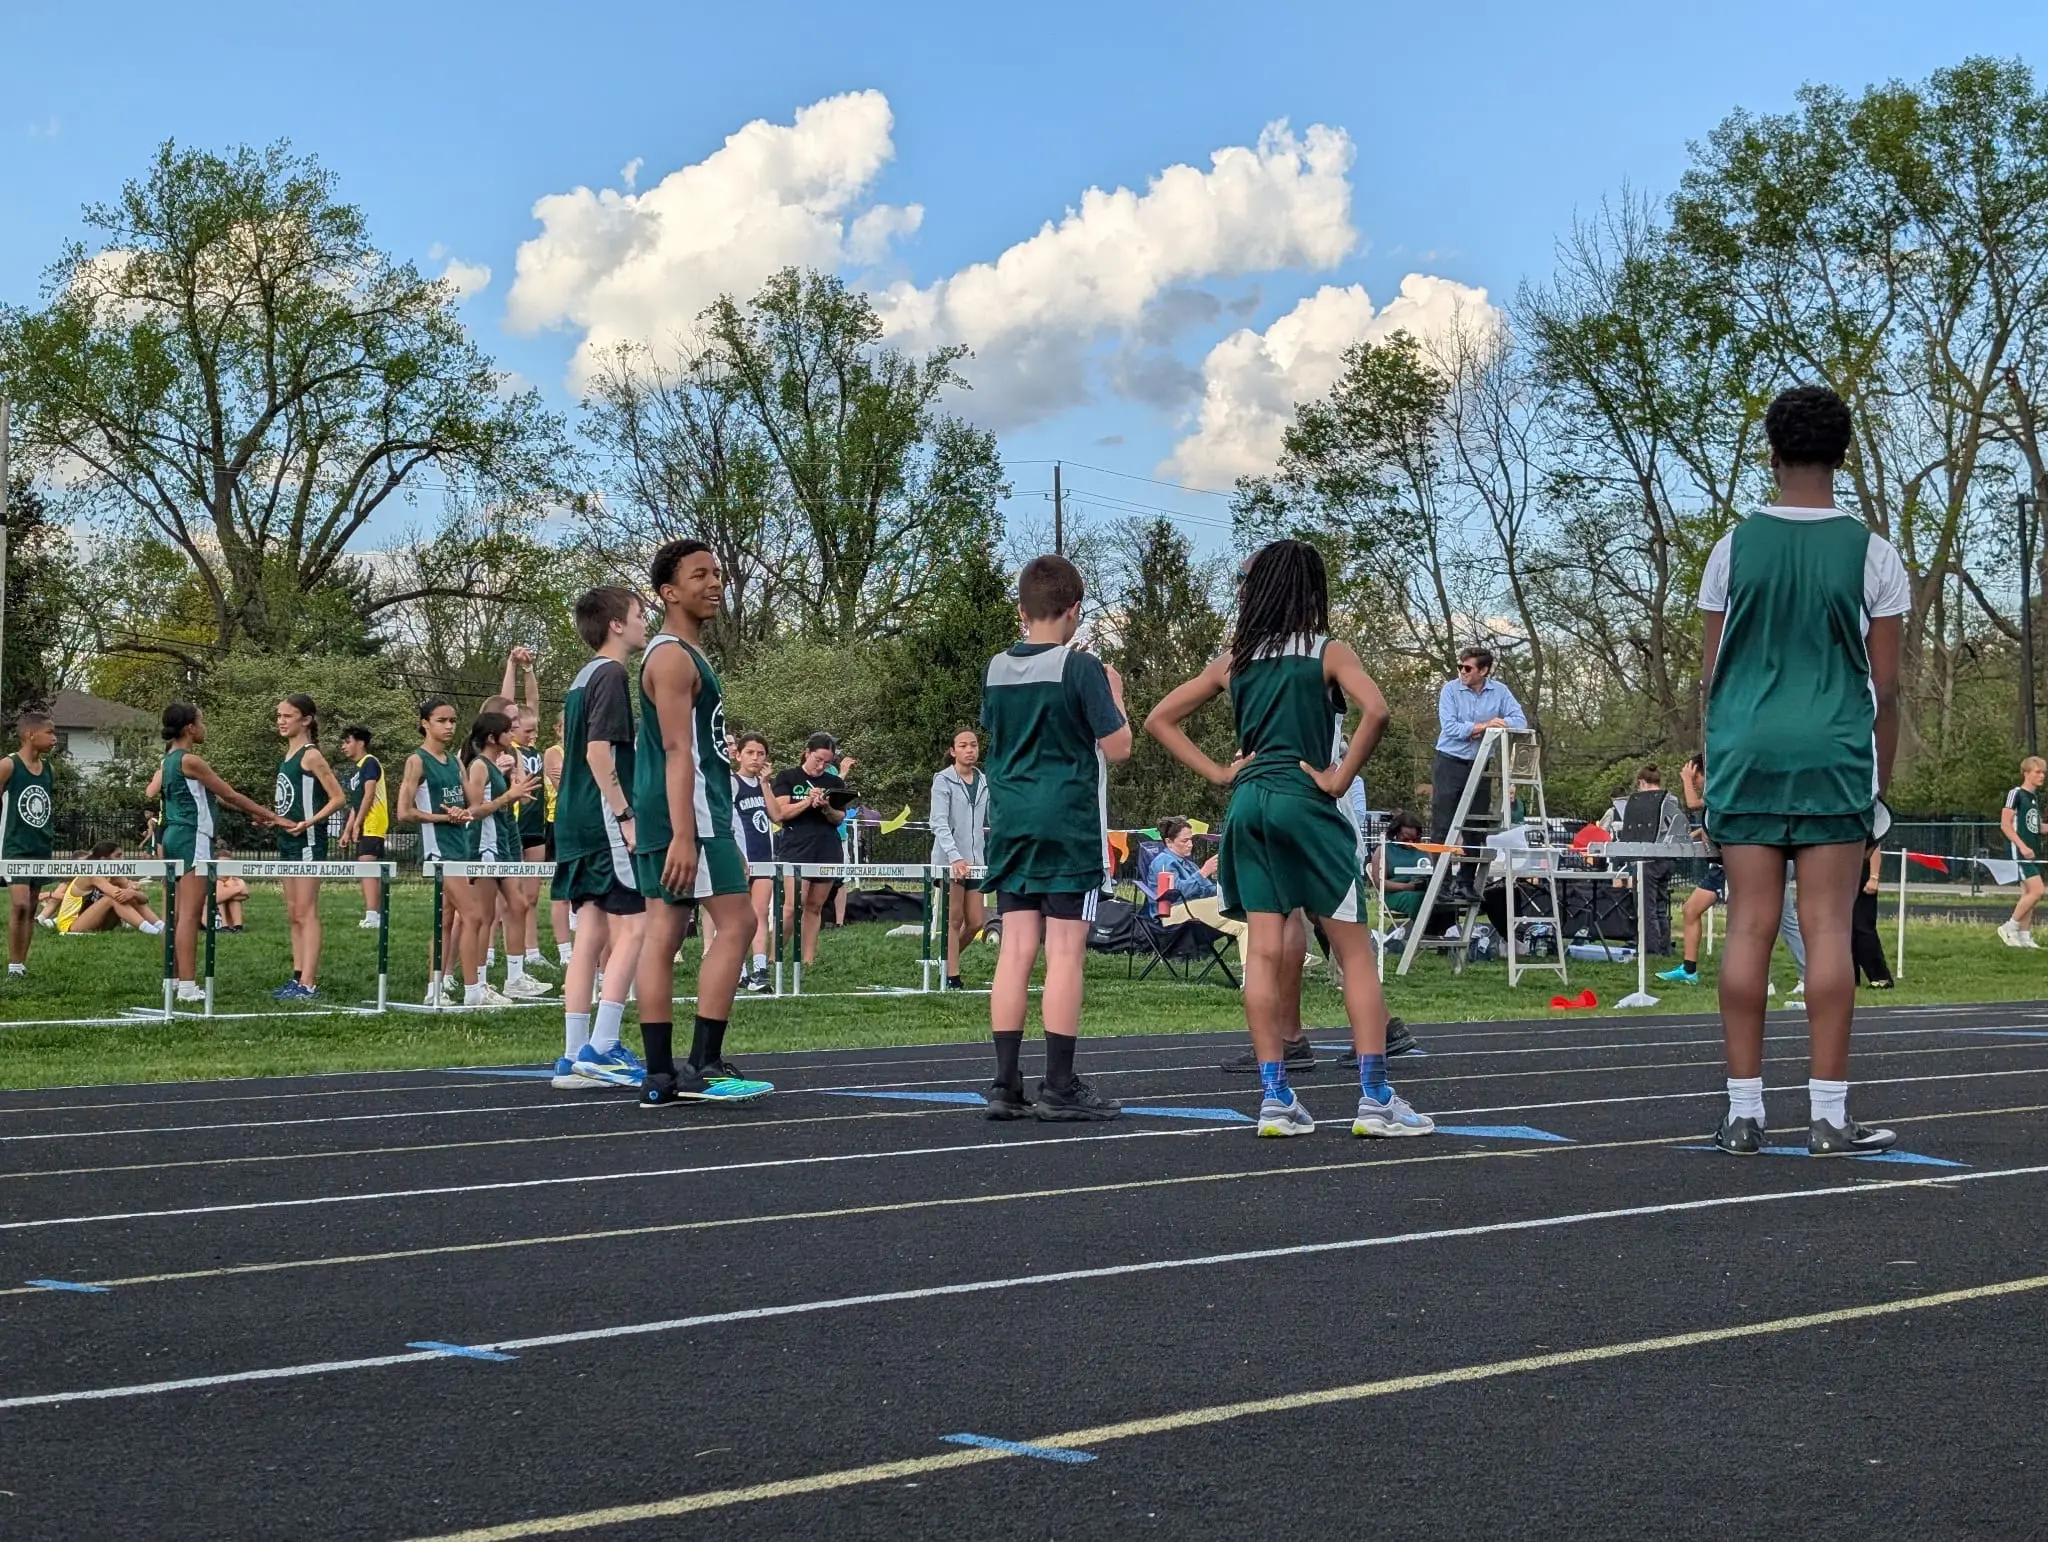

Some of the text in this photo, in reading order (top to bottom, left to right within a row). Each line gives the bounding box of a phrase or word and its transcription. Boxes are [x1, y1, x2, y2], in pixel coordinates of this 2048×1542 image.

[7, 863, 136, 875] GIFT OF ORCHARD ALUMNI
[242, 864, 355, 876] GIFT OF ORCHARD ALUMNI
[466, 865, 555, 875] GIFT OF ORCHARD ALU
[819, 866, 905, 876] GIFT OF ORCHARD ALUMNI
